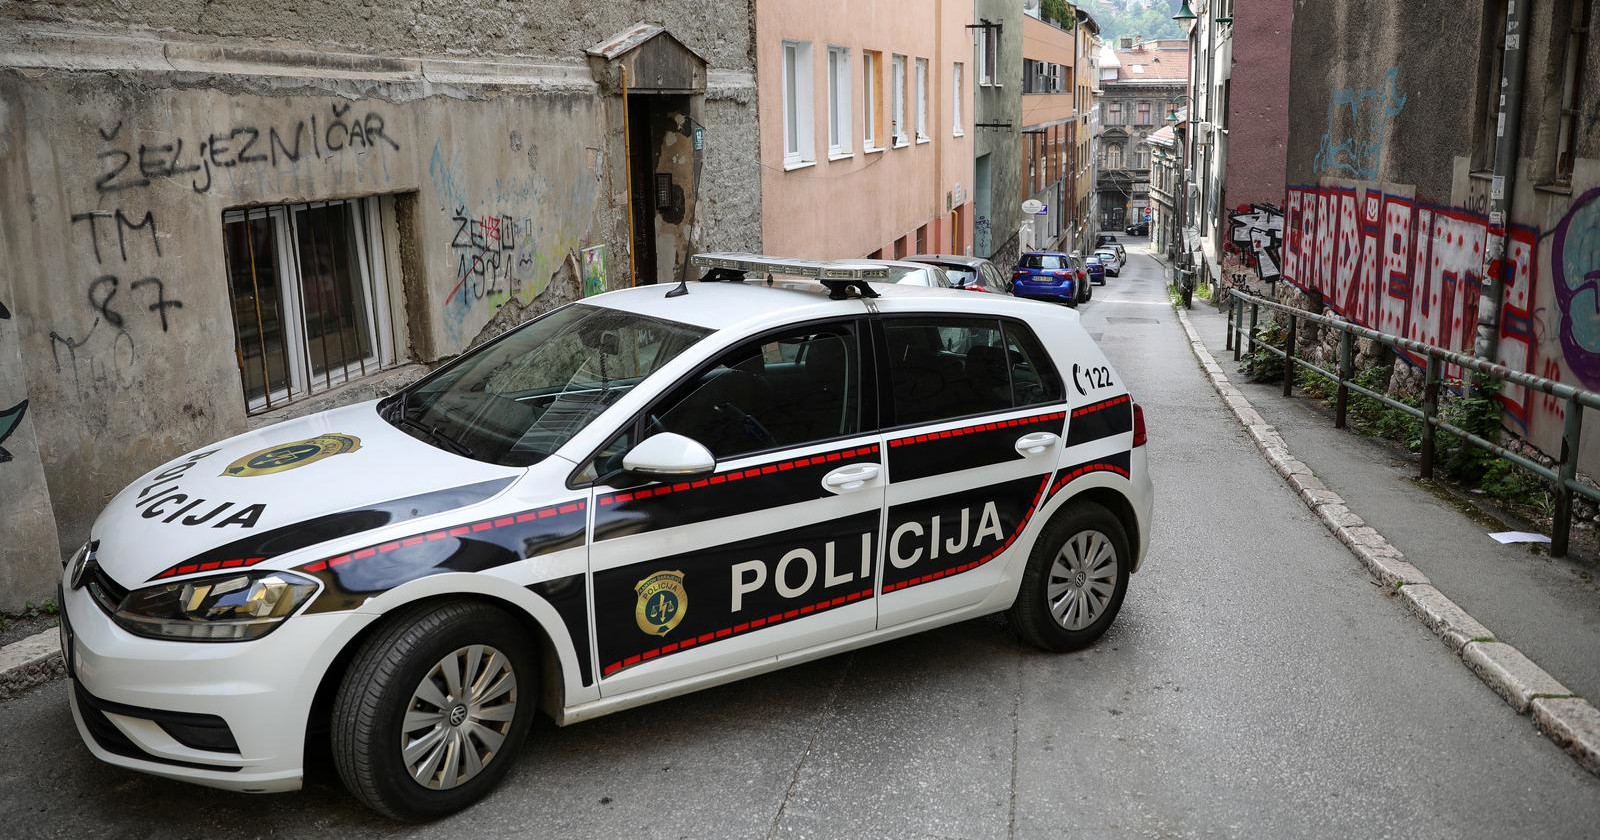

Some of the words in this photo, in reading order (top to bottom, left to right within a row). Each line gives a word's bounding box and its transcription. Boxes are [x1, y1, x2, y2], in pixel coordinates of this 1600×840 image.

[72, 208, 162, 264] TM
[88, 274, 183, 332] 87
[1084, 366, 1114, 389] 122
[135, 448, 267, 529] POLICIJA
[731, 501, 1004, 612] POLICIJA
[642, 582, 678, 600] POLICIJA
